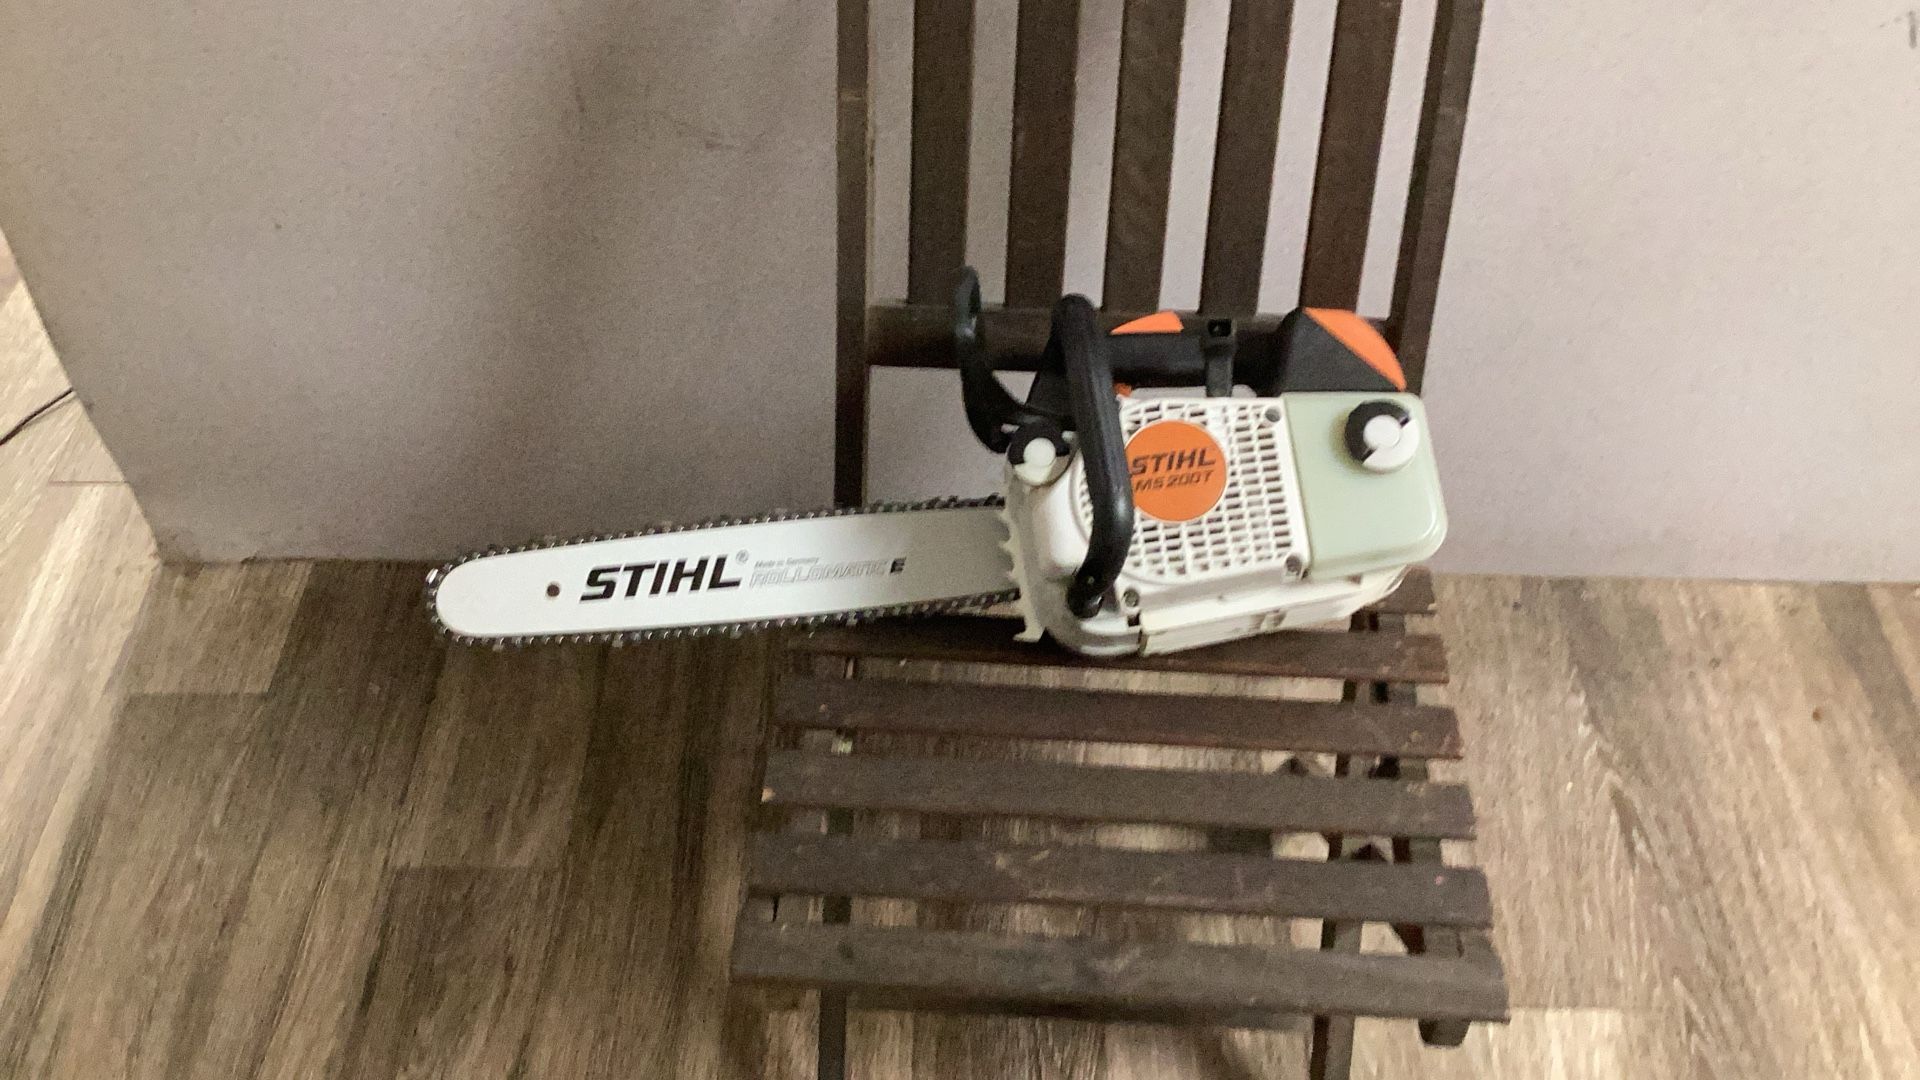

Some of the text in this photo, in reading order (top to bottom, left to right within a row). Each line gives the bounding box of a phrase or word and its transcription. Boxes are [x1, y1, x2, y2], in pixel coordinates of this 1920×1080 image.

[1131, 448, 1216, 475] STIHL
[1135, 476, 1165, 491] MS
[580, 554, 741, 601] STIHL
